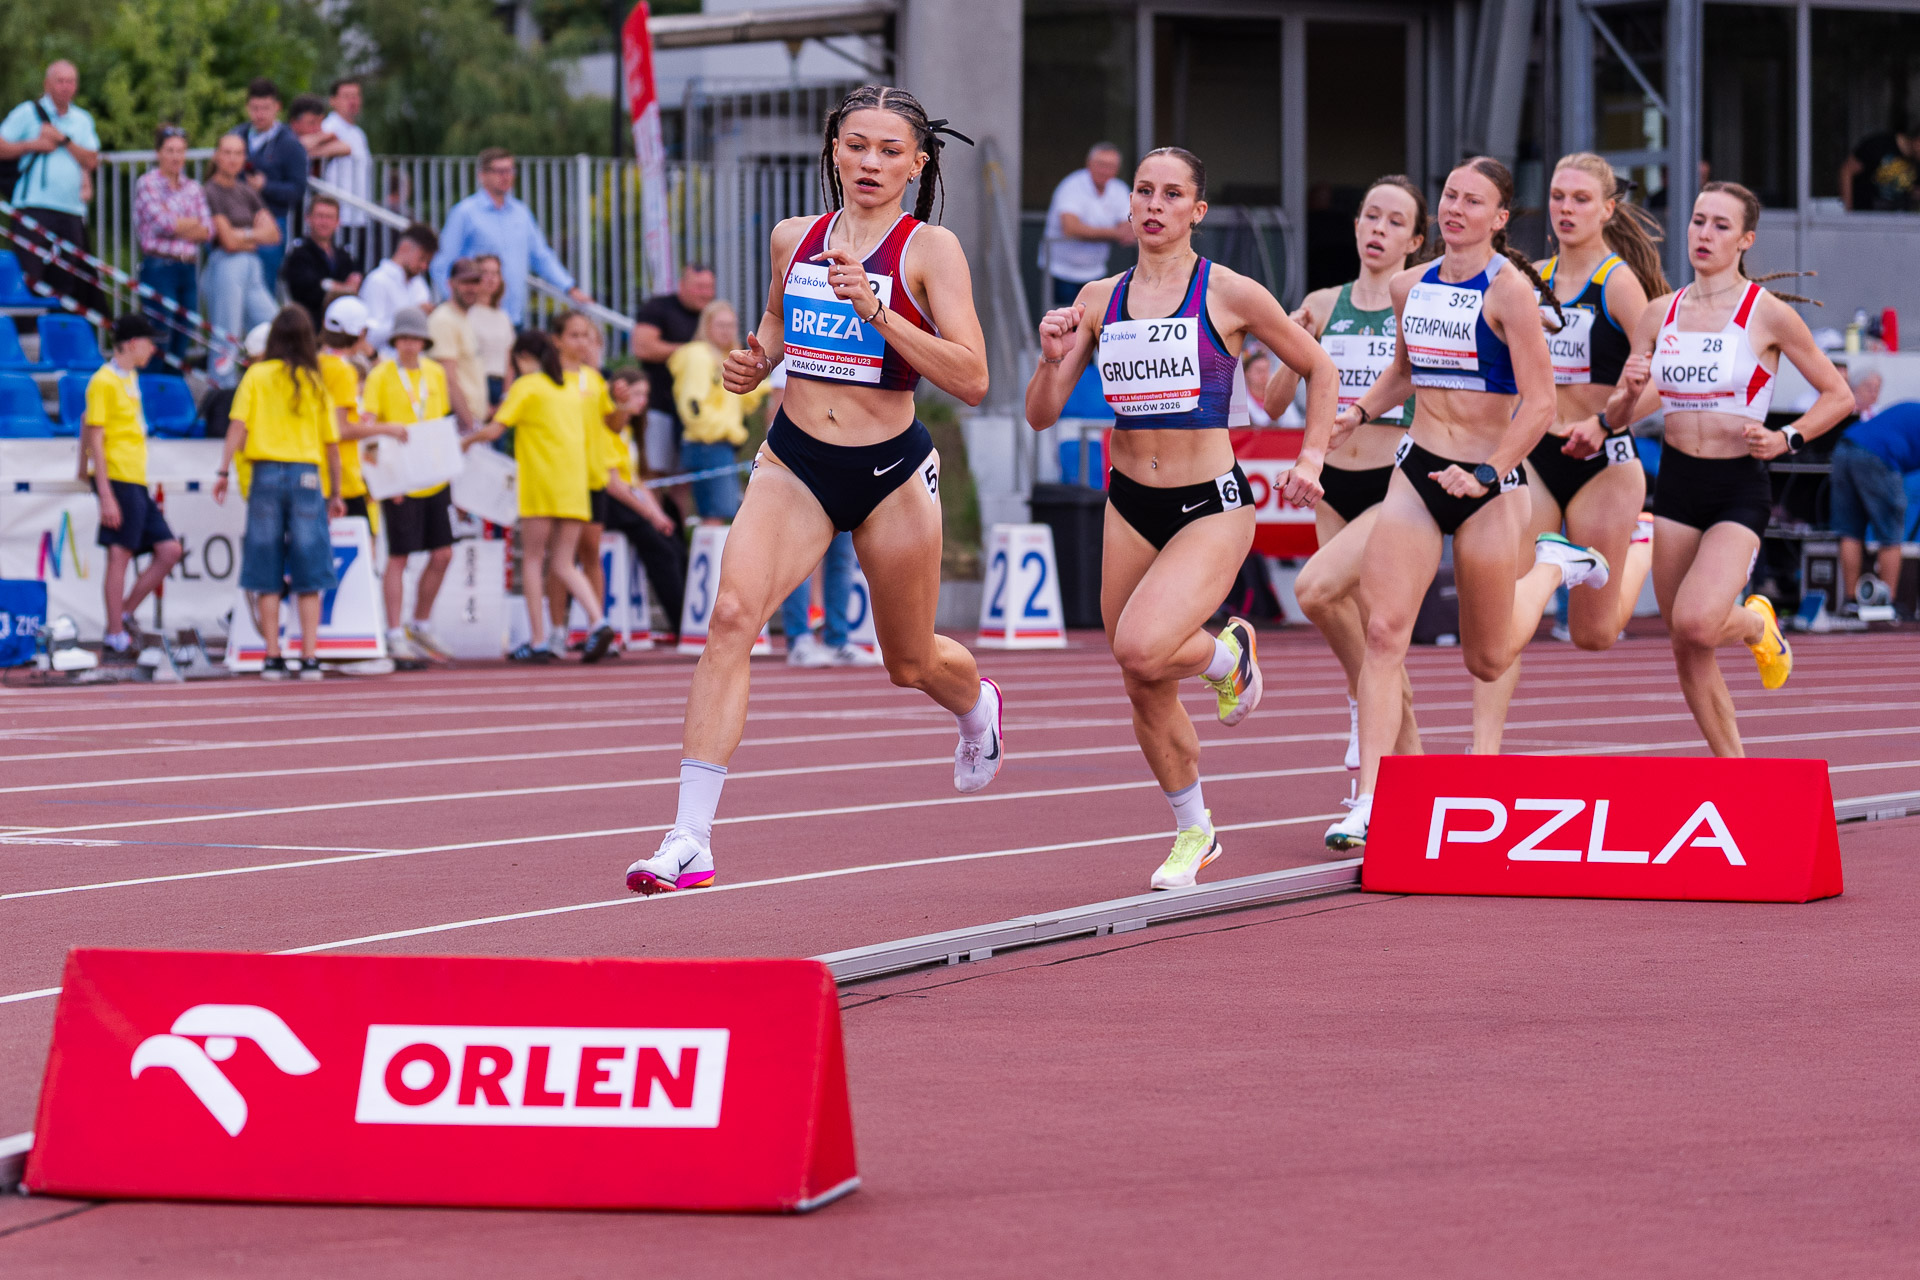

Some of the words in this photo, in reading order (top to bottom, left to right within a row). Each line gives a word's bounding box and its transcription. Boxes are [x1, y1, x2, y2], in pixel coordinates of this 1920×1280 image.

[794, 274, 827, 288] Kraków
[1449, 292, 1477, 309] 392
[791, 307, 864, 341] BREZA
[1148, 323, 1187, 342] 270
[1404, 315, 1471, 341] STEMPNIAK
[1111, 331, 1137, 340] Kraków
[1702, 338, 1723, 353] 28
[803, 349, 835, 360] Mistrzostwa
[836, 355, 856, 363] Polski
[1548, 340, 1585, 358] LCZUK
[792, 359, 826, 373] KRAKÓW
[829, 365, 856, 376] 2026
[1102, 356, 1194, 382] GRUCHAŁA
[1338, 365, 1382, 387] RZEŻY
[1662, 361, 1719, 383] KOPEĆ
[1121, 402, 1158, 413] KRAKÓW
[1160, 402, 1181, 410] 2026
[1131, 393, 1162, 401] Mistrzostwa
[1614, 441, 1629, 461] 8
[925, 464, 937, 493] 5
[1222, 480, 1238, 503] 6
[691, 553, 710, 623] 3
[989, 551, 1008, 618] 2
[1022, 552, 1049, 617] 2
[1426, 797, 1747, 866] PZLA
[384, 1043, 700, 1109] ORLEN
